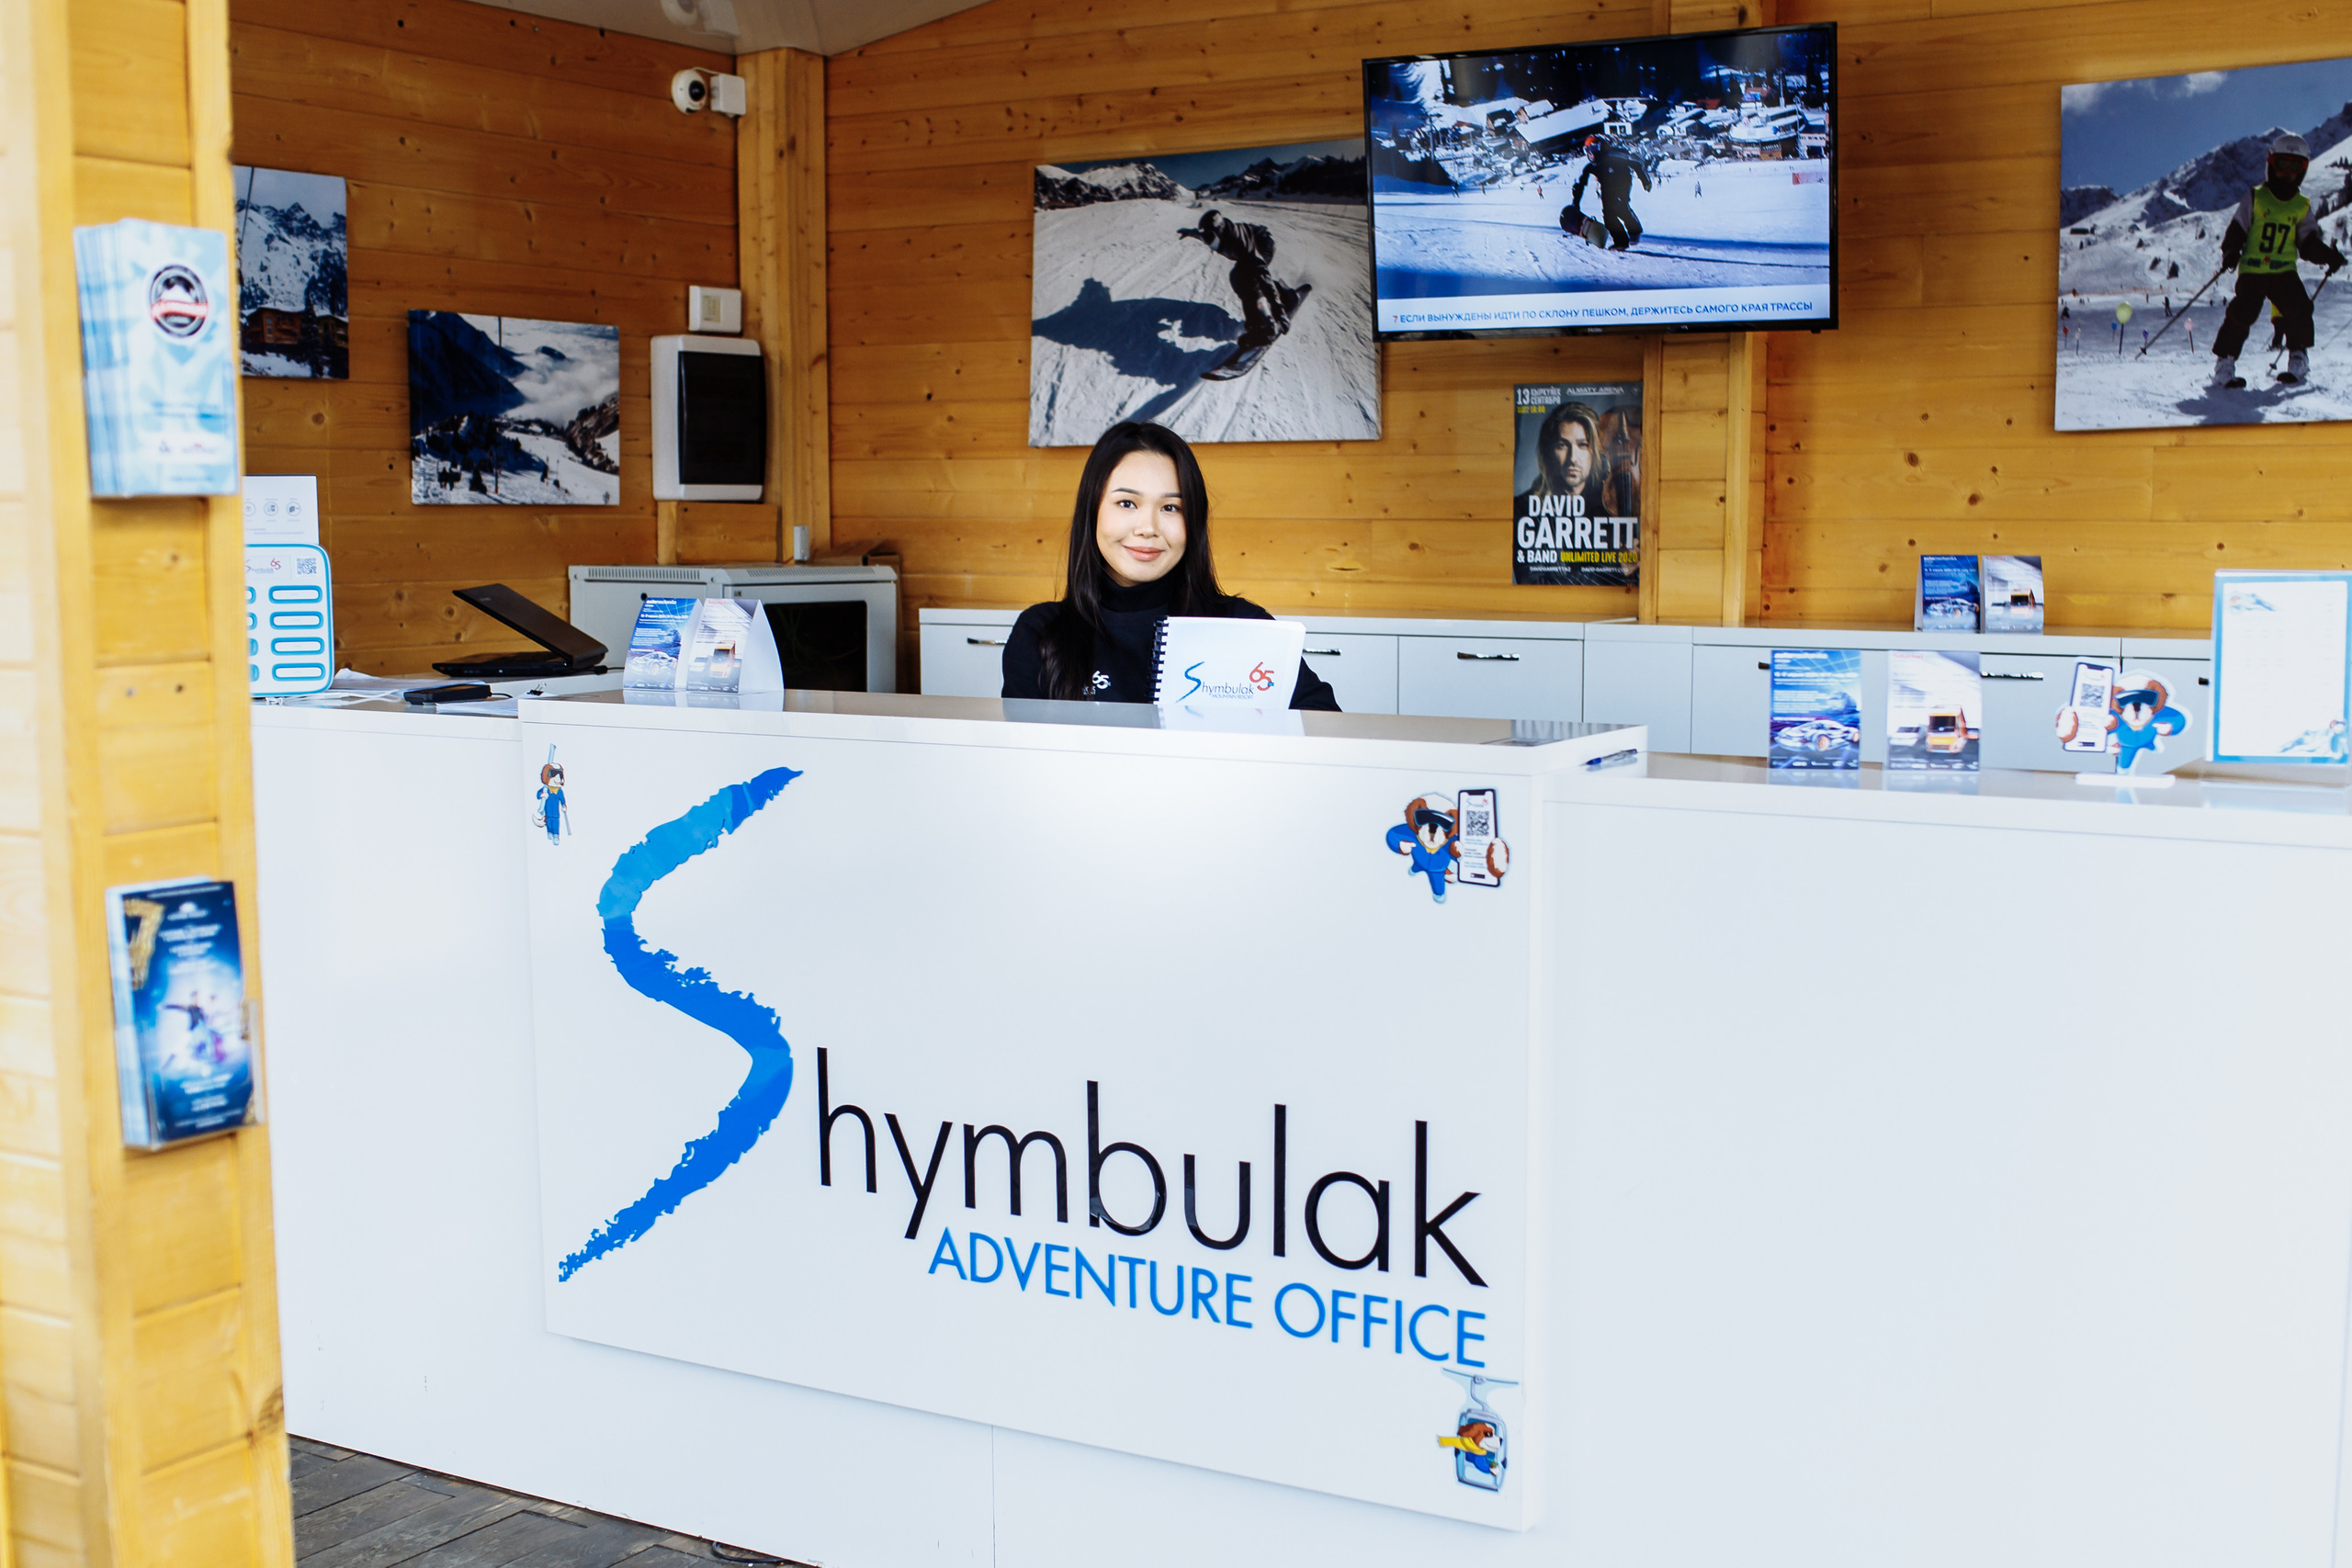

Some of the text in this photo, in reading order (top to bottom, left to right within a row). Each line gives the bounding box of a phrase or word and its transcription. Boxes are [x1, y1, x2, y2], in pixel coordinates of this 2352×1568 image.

[2259, 222, 2290, 254] 97
[1392, 301, 1813, 323] 7 ЕСЛИ ВЫНУЖДЕНЫ ИДТИ ПО СКЛОНУ ПЕШКОМ, ДЕРЖИТЕСЬ САМОГО КРАЯ ТРАССЫ
[1517, 388, 1530, 405] 13
[1529, 494, 1586, 517] DAVID
[1517, 516, 1638, 549] GARRETT
[1517, 549, 1638, 563] & BAND UNLIMITED LIVE 2020
[1091, 670, 1111, 691] 65
[1175, 660, 1273, 704] Shymbulak 65
[559, 767, 1489, 1289] Shymbulak
[928, 1227, 1487, 1369] ADVENTURE OFFICE
